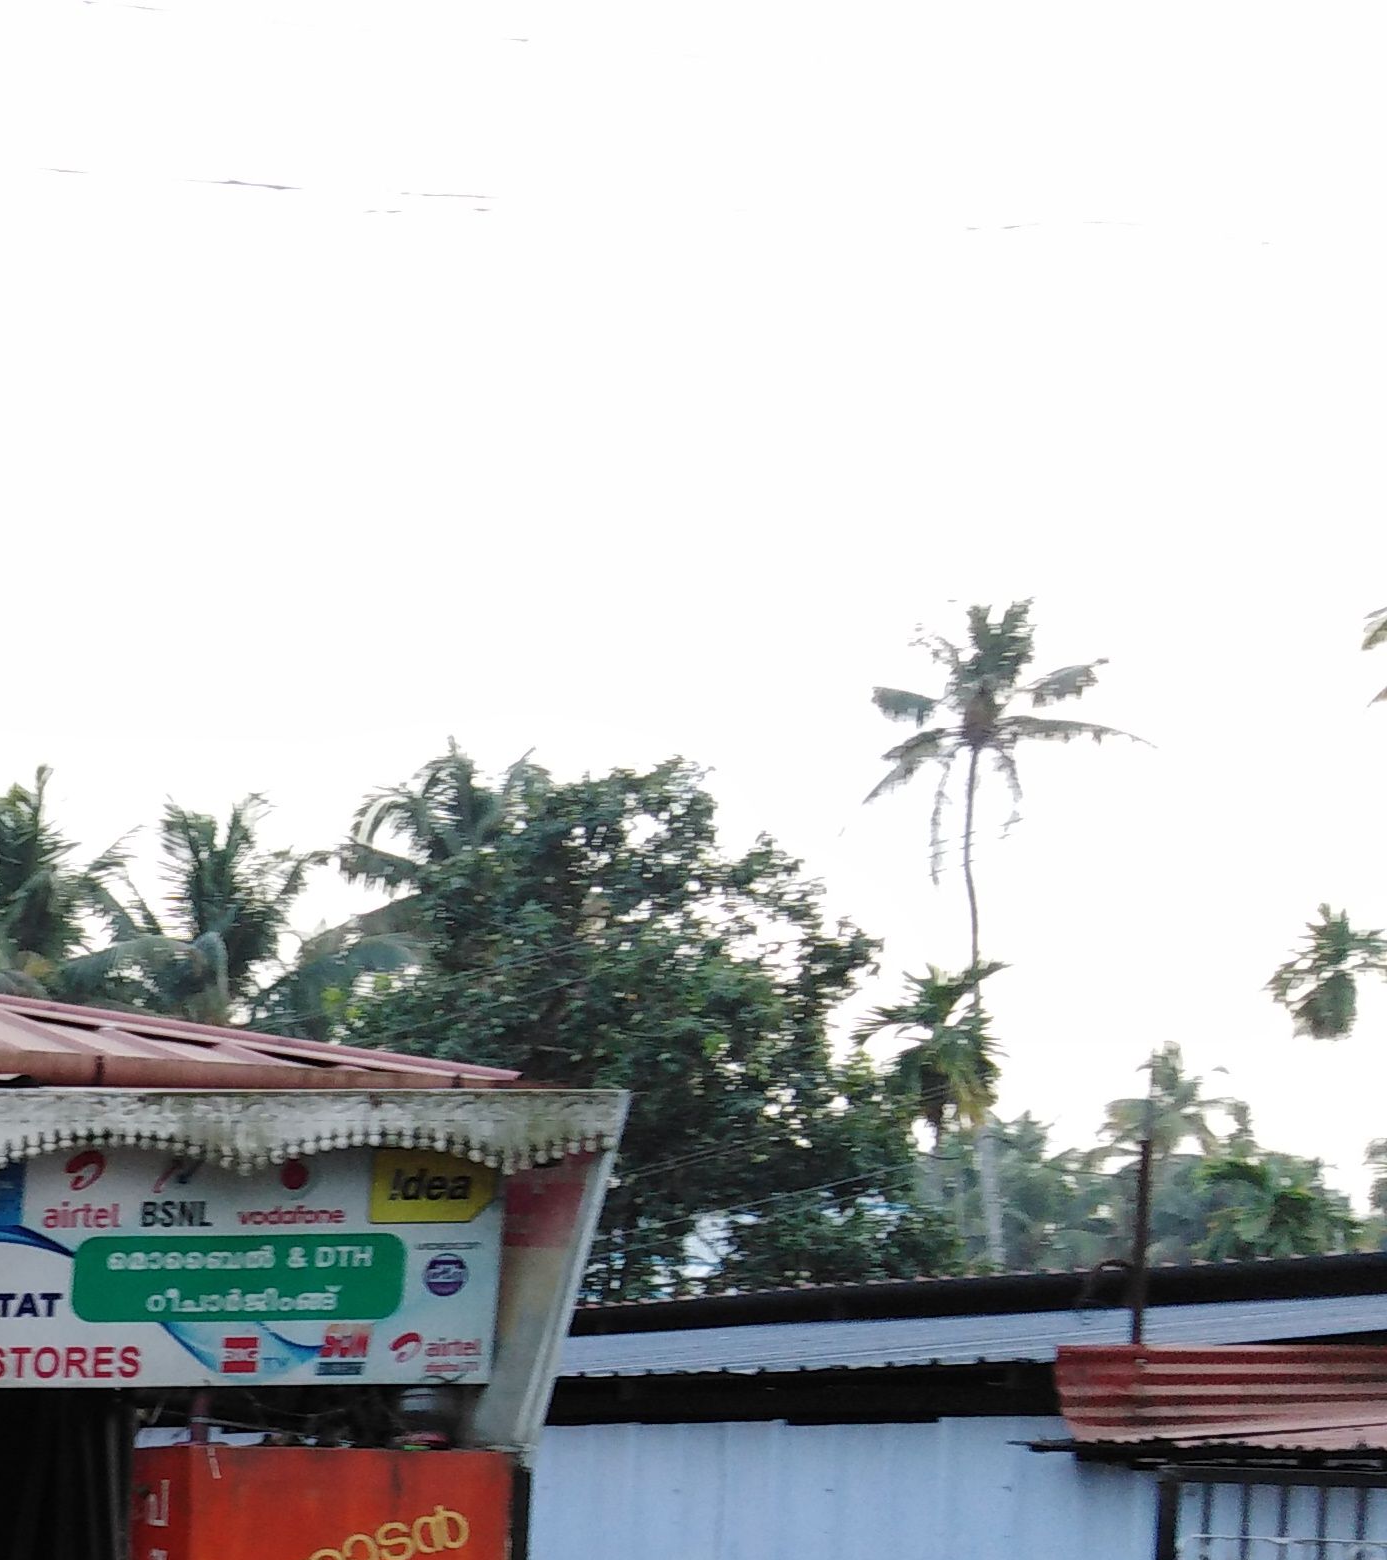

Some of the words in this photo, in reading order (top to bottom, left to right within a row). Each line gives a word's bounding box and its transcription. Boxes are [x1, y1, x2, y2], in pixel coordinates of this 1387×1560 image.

[42, 1202, 121, 1229] airtel
[140, 1201, 214, 1228] BSNL
[237, 1205, 348, 1226] vodafone
[314, 1245, 374, 1269] DTH
